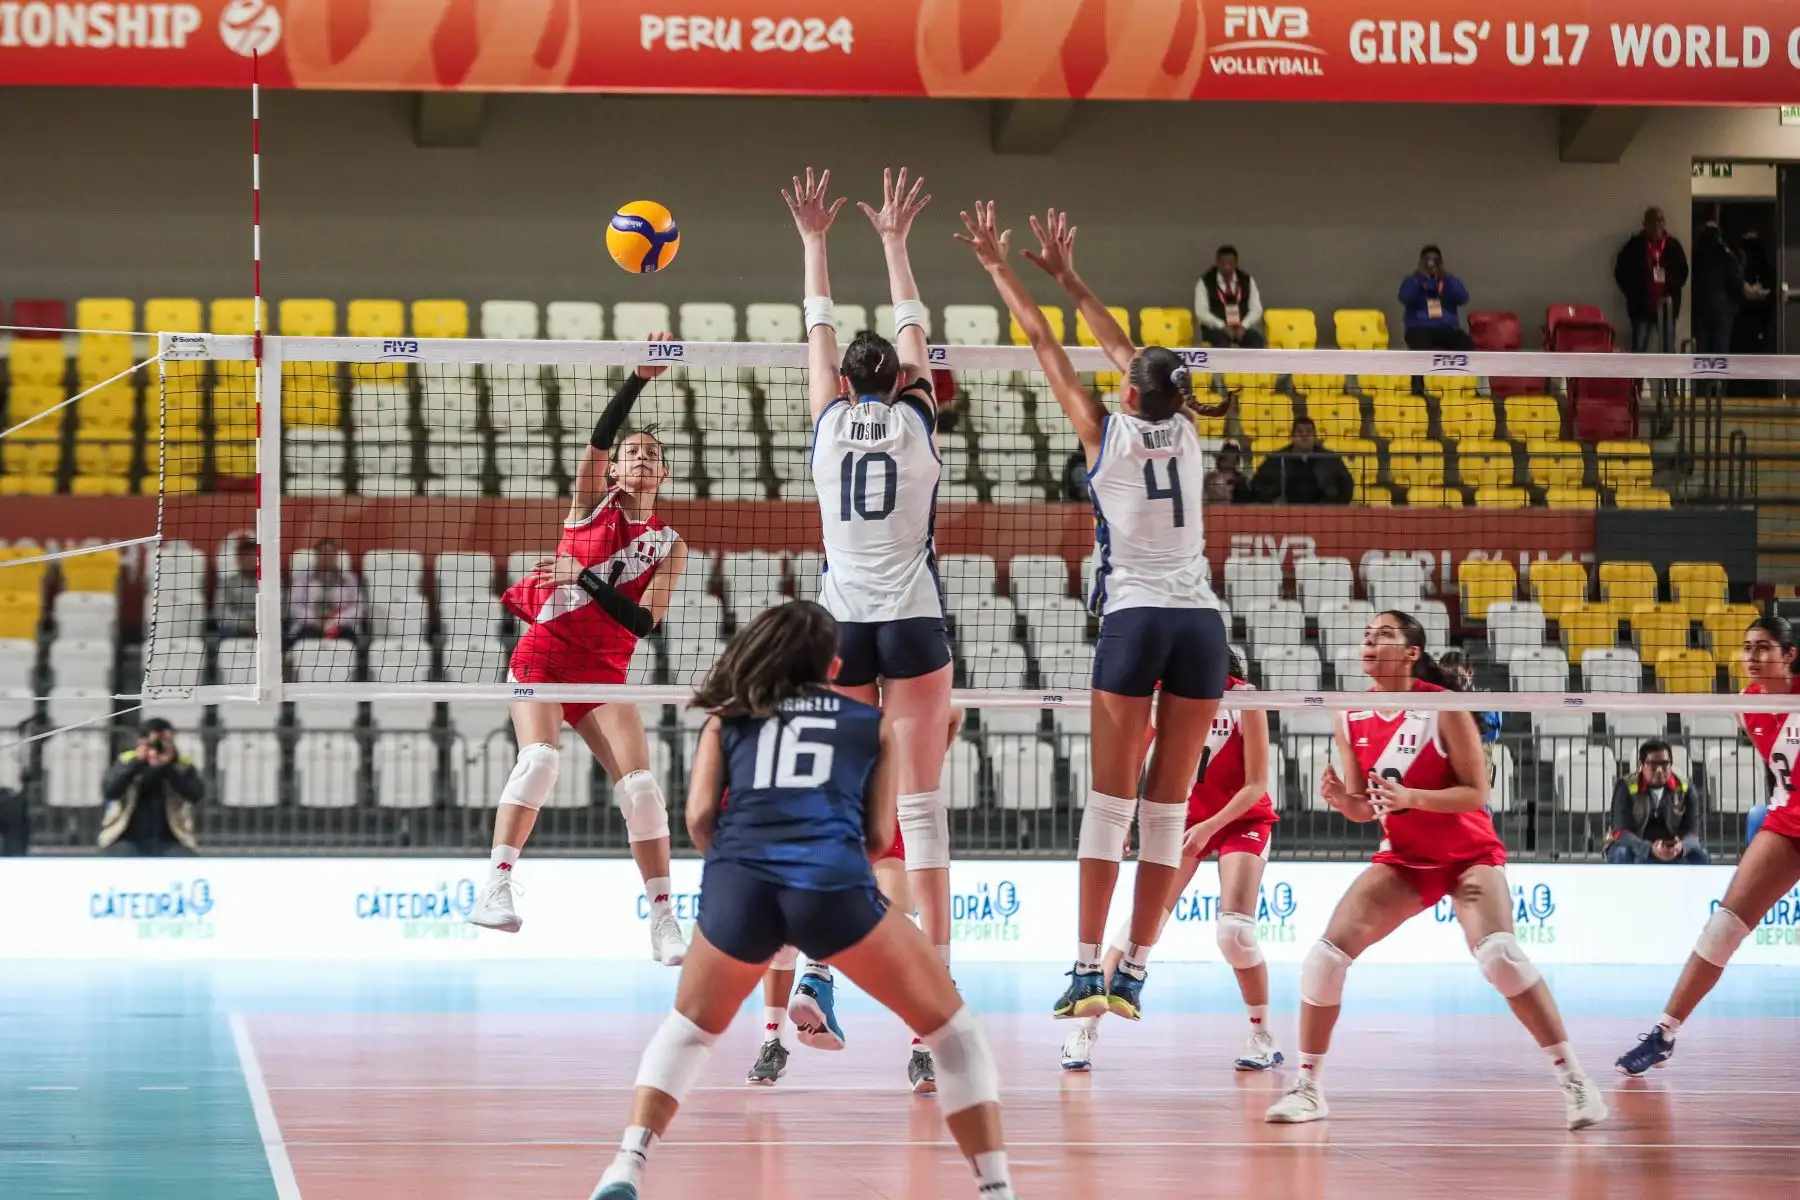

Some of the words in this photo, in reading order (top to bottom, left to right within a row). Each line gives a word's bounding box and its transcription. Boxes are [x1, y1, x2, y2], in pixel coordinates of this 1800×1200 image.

[0, 3, 201, 48] IONSHIP
[640, 14, 742, 51] PERU
[751, 16, 854, 54] 2024
[1224, 6, 1309, 38] FIVB
[1506, 22, 1590, 66] U17
[1610, 24, 1771, 68] WORLD
[1209, 56, 1325, 75] VOLLEYBALL
[383, 341, 418, 352] FIVB
[649, 345, 683, 356] FIVB
[1433, 354, 1468, 366] FIVB
[1694, 357, 1728, 369] FIVB
[841, 451, 897, 521] 10
[1143, 457, 1184, 527] 4
[753, 716, 837, 789] 16
